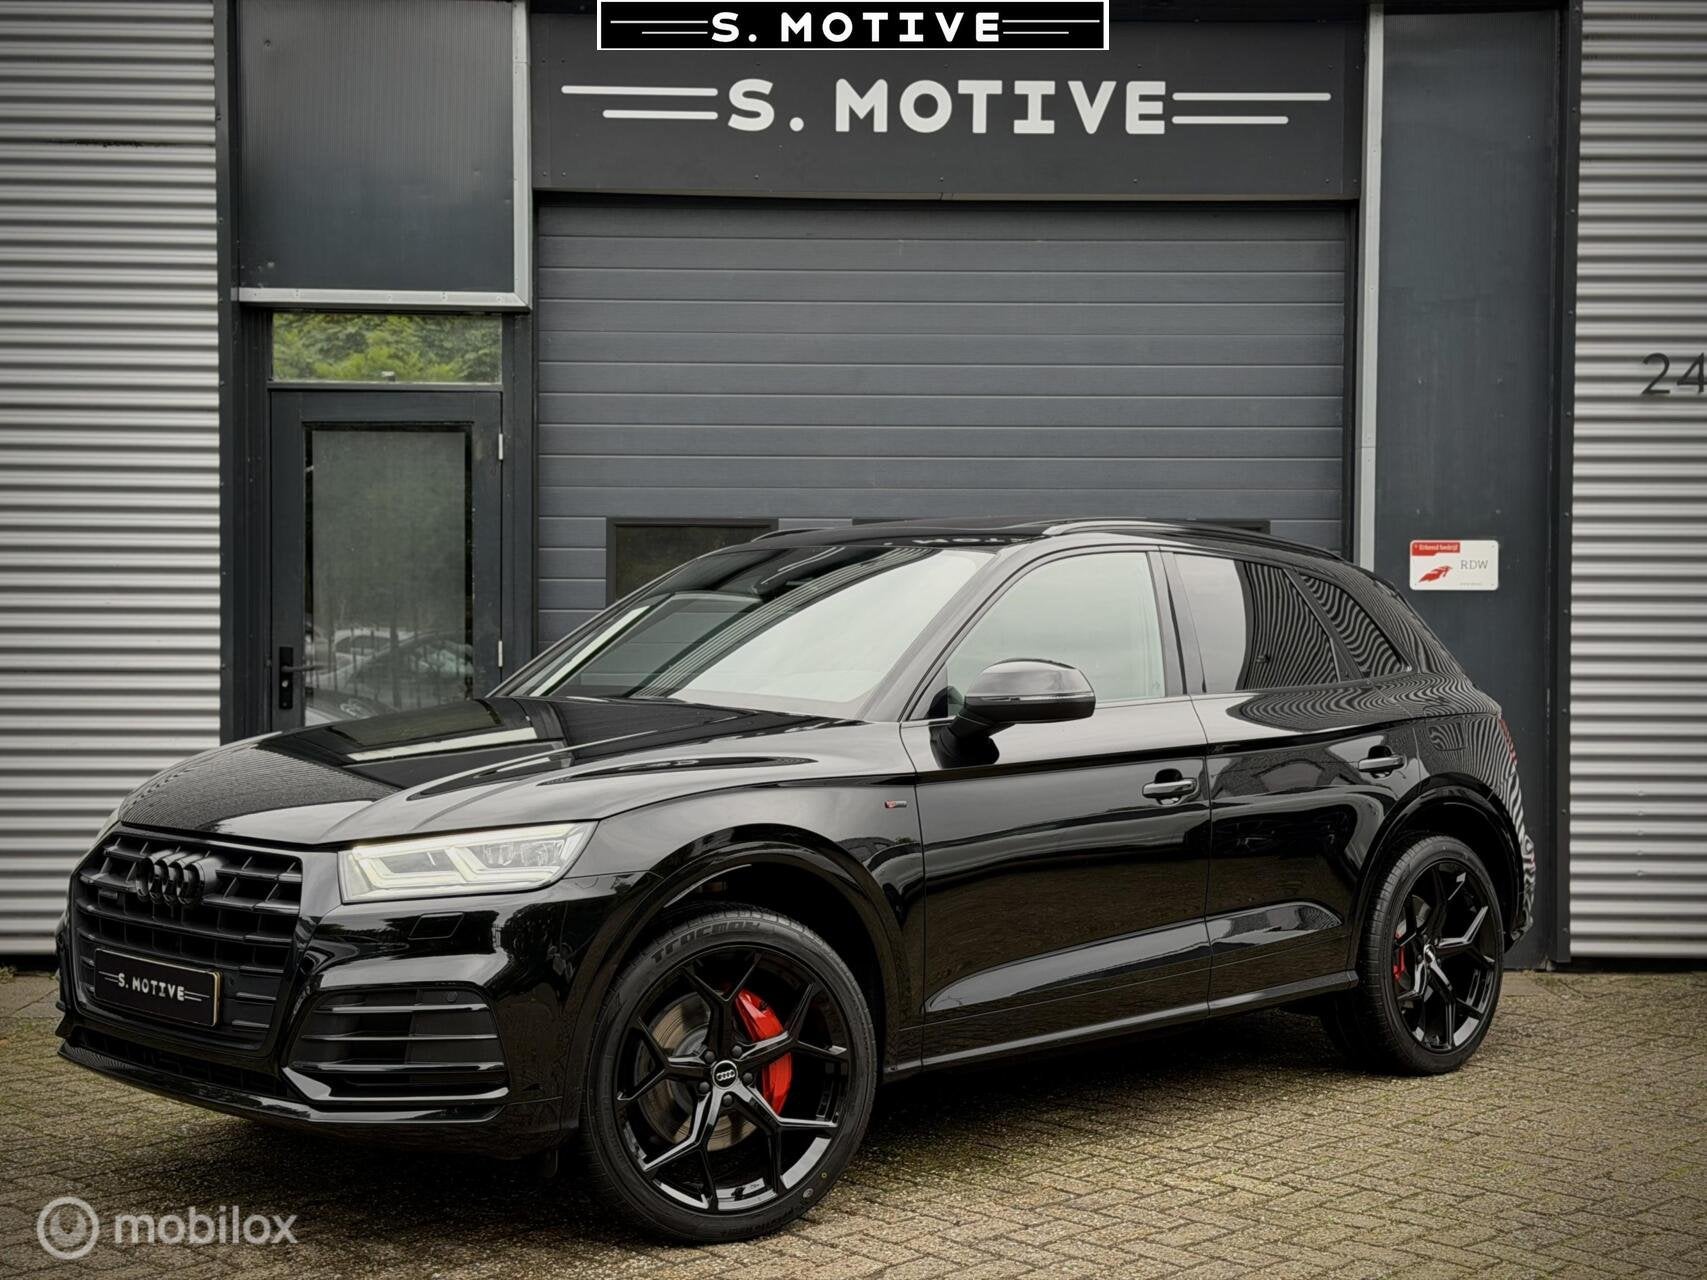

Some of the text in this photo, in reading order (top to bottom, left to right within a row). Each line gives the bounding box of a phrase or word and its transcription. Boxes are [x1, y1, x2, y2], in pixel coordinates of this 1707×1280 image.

[727, 78, 1166, 135] S. MOTIVE
[1641, 352, 1707, 395] 24
[1460, 559, 1489, 570] RDW
[118, 972, 185, 1002] S. MOTIVE
